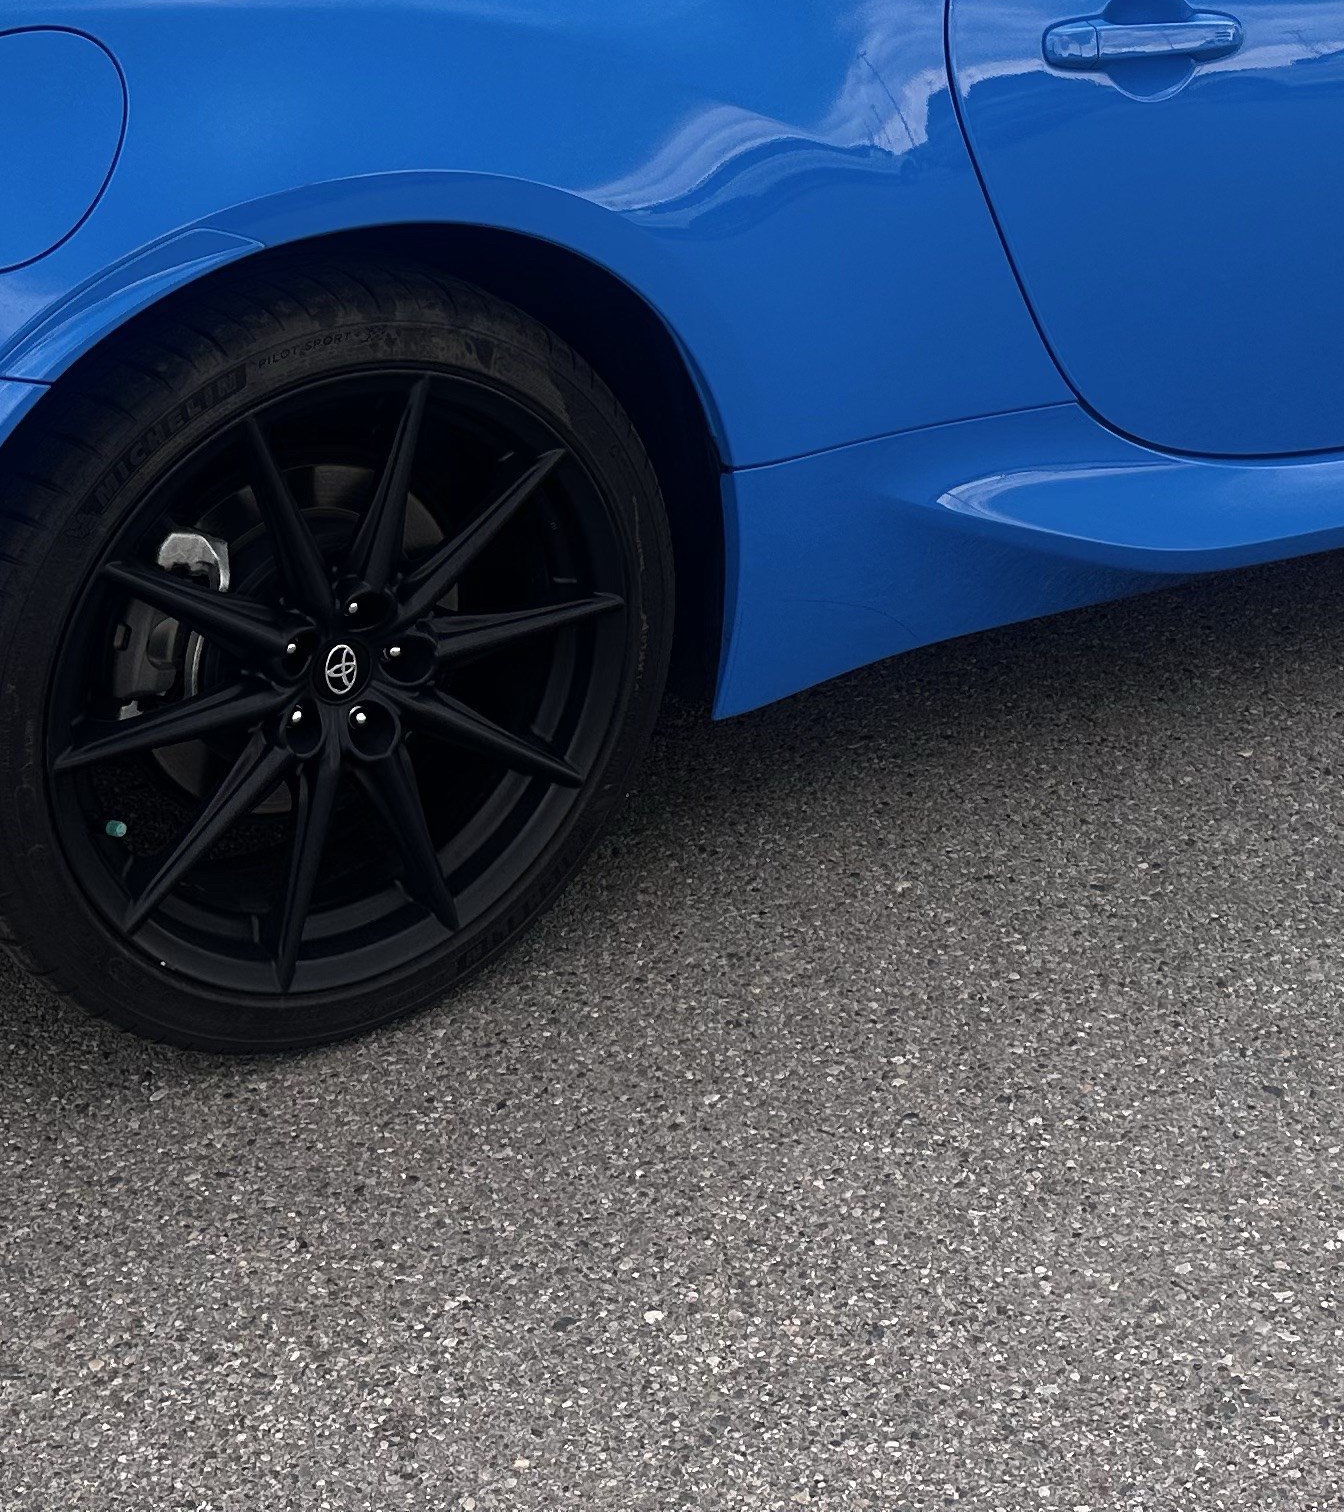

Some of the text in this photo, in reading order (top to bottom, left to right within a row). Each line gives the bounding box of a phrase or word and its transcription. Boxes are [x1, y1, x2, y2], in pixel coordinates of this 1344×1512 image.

[96, 370, 238, 508] MICHELIN
[258, 346, 301, 370] PILOT
[302, 331, 351, 354] SPORT
